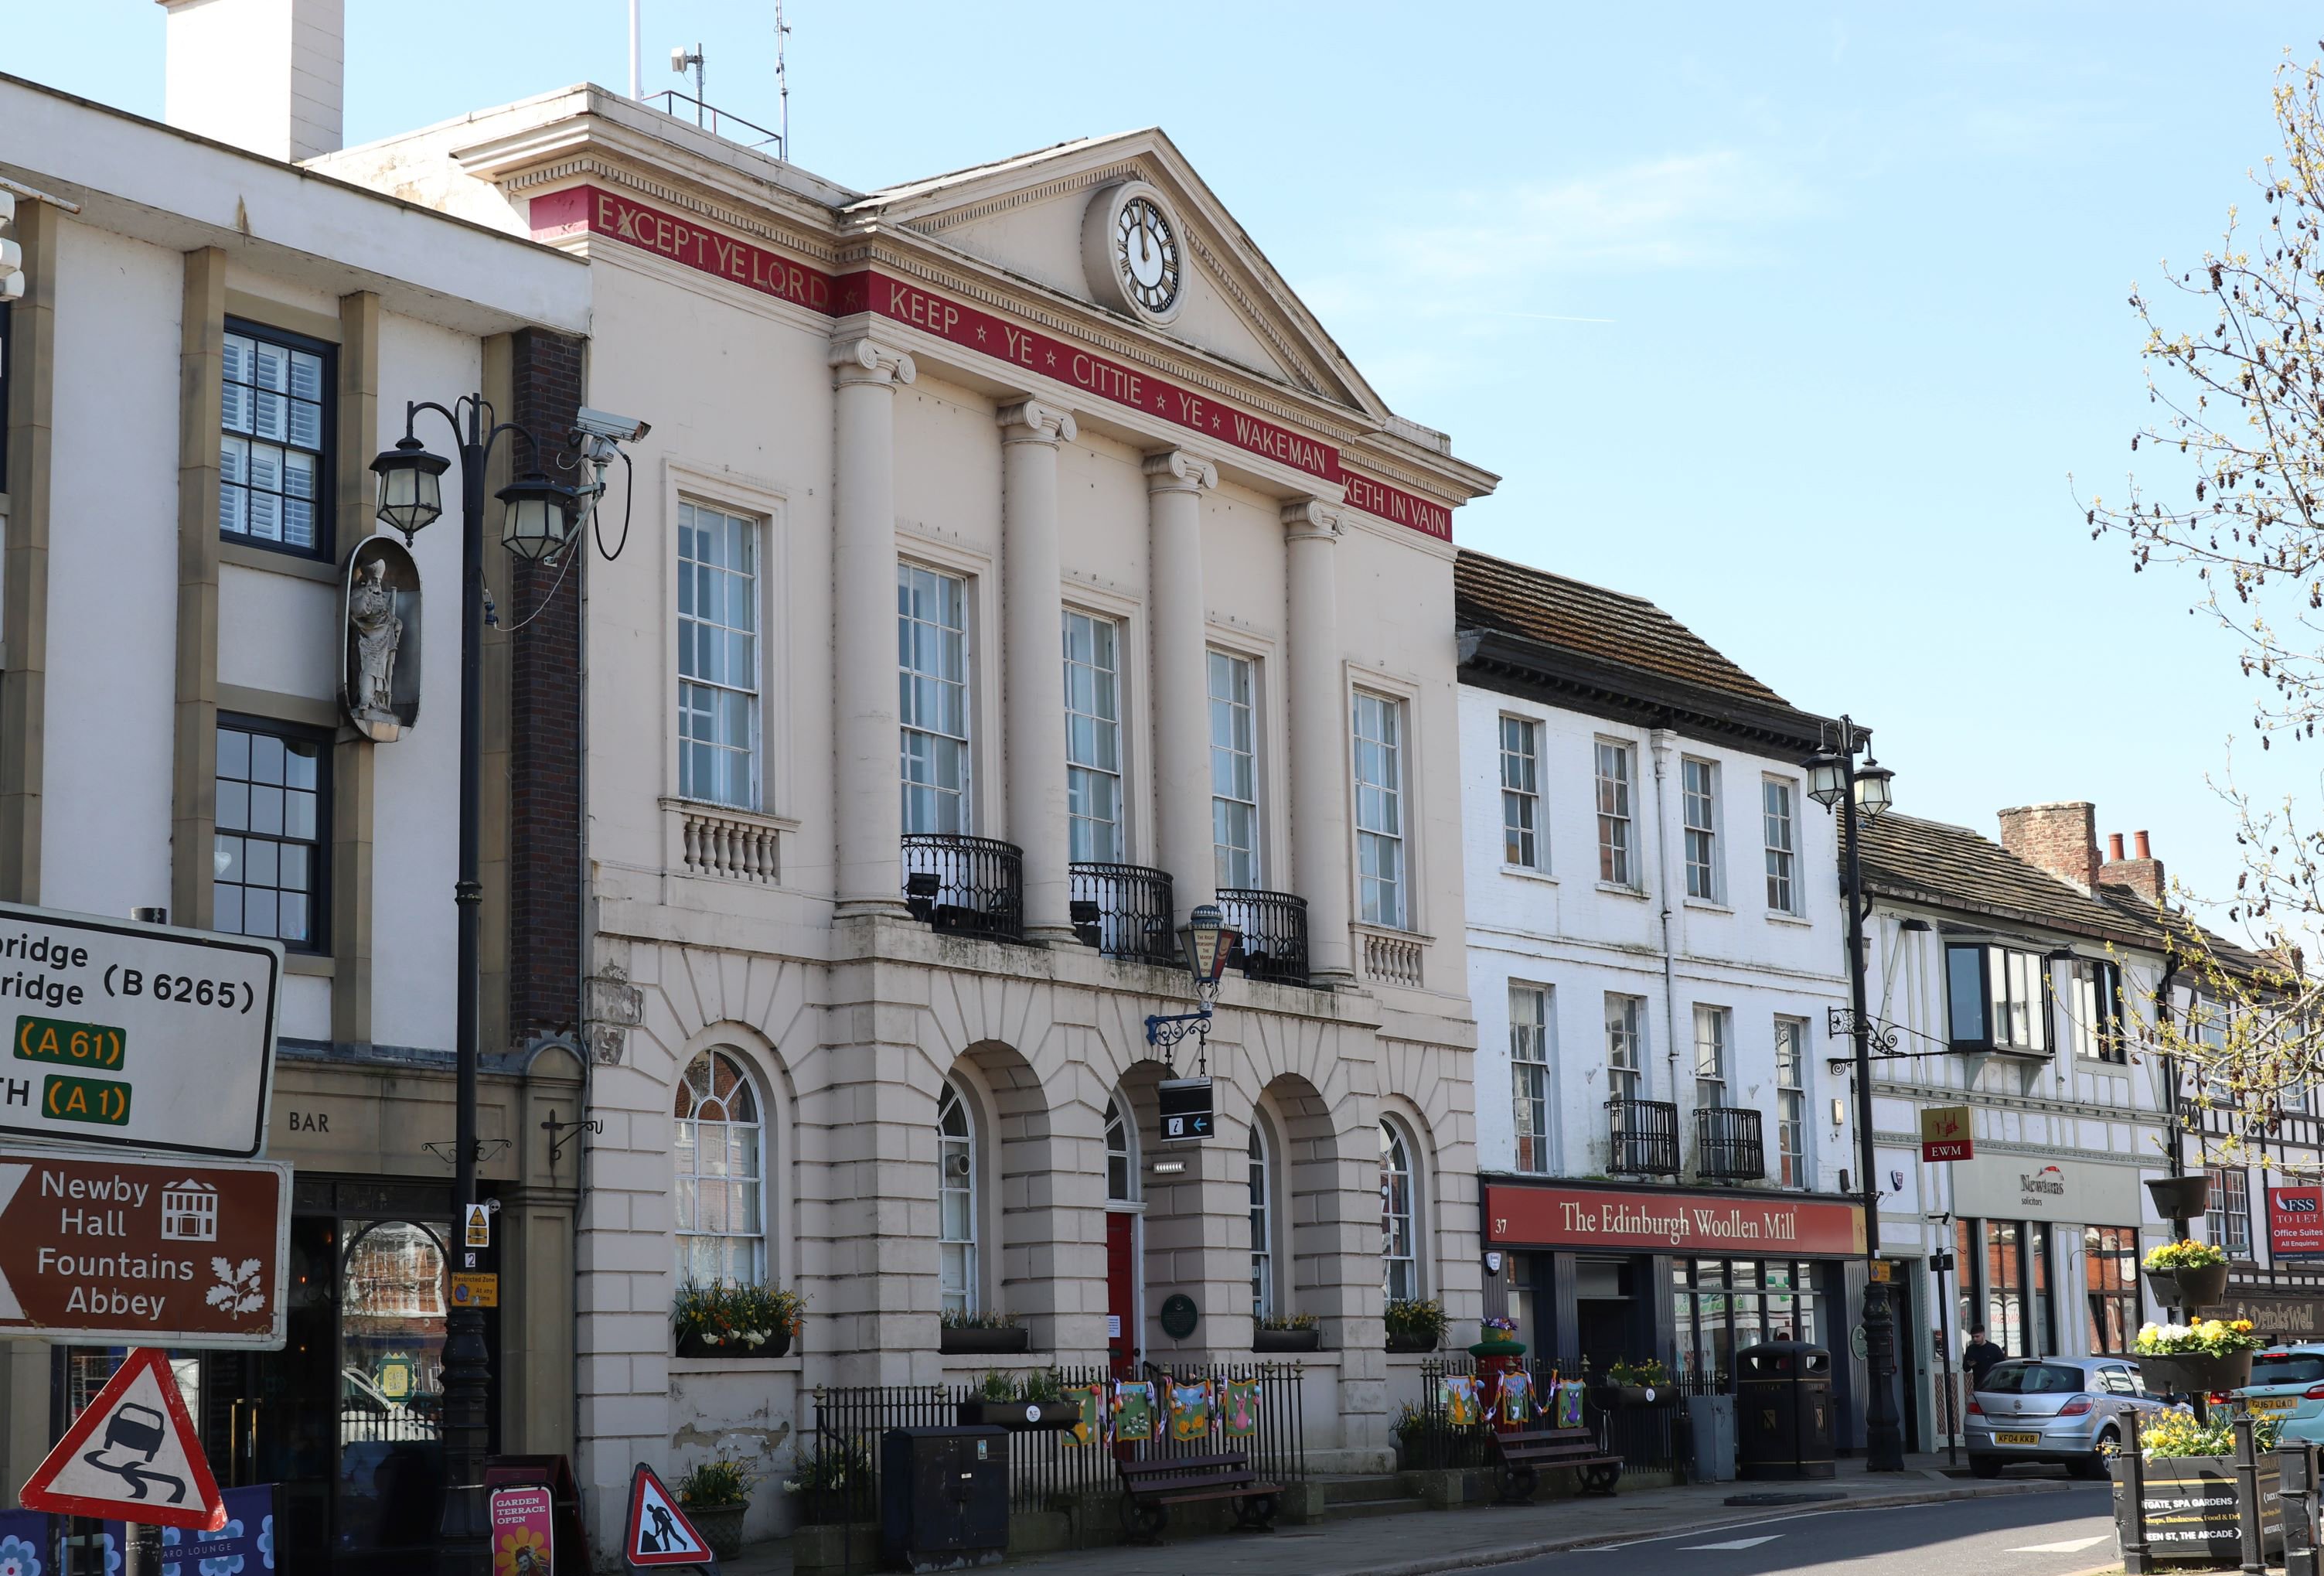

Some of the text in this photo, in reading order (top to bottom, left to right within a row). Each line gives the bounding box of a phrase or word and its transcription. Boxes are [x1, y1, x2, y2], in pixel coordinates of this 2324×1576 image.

[598, 194, 829, 309] EXCEPT YE LORD
[890, 283, 1325, 474] KEEP YE CITTIE YE WAKEMAN
[1392, 491, 1406, 520] IN
[1411, 502, 1446, 536] VAIN
[104, 964, 254, 1014] (B 6265)
[21, 1022, 120, 1065] (A 61)
[49, 1081, 87, 1114] (A
[99, 1085, 124, 1120] 1)
[289, 1111, 329, 1133] BAR
[1931, 1146, 1961, 1157] EWM
[42, 1170, 148, 1206] Newby
[2021, 1196, 2042, 1206] solicitors
[2288, 1199, 2315, 1212] FSS
[61, 1208, 126, 1237] Hall
[1559, 1202, 1796, 1245] The Edinburgh Woollen Mill
[2276, 1213, 2318, 1223] TO LET
[1495, 1219, 1507, 1234] 37
[2291, 1240, 2319, 1248] Enquiries
[38, 1248, 193, 1281] Fountains
[468, 1254, 475, 1266] 2
[66, 1287, 165, 1320] Abbey
[387, 1372, 404, 1380] CAFE
[390, 1382, 402, 1390] BAR
[496, 1498, 540, 1507] GARDEN
[2173, 1499, 2191, 1508] SPA
[2192, 1497, 2233, 1507] GARDENS
[497, 1506, 546, 1516] TERRACE
[497, 1516, 526, 1525] OPEN
[2165, 1532, 2179, 1542] ST,
[2179, 1531, 2196, 1540] THE
[2197, 1530, 2233, 1540] ARCADE
[189, 1543, 232, 1557] LOUNGE
